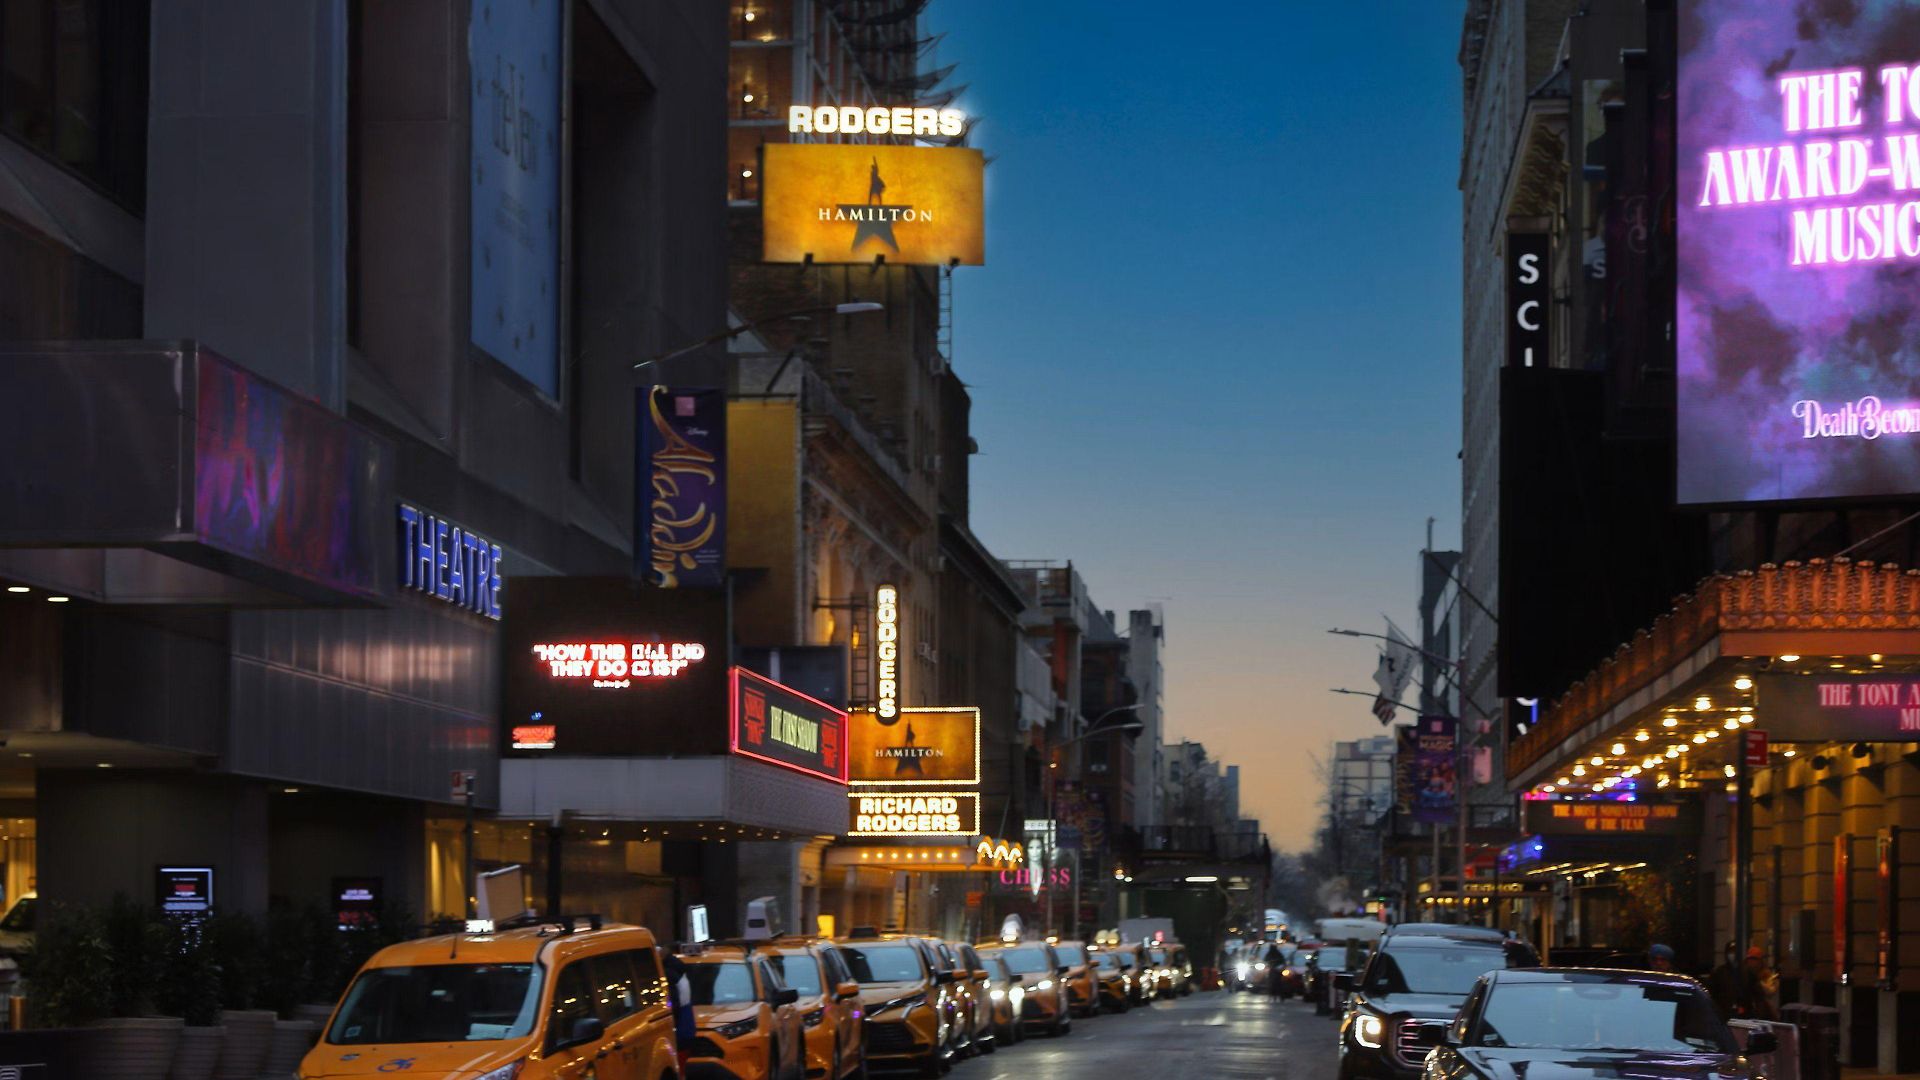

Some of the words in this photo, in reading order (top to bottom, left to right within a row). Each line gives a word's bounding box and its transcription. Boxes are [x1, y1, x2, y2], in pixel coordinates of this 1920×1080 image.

[1780, 71, 1862, 132] THE
[789, 105, 963, 136] RODGERS
[818, 207, 933, 222] HAMILTON
[1791, 201, 1920, 265] MUSIC
[399, 502, 502, 621] THEATRE
[671, 643, 705, 661] DID
[877, 588, 897, 718] RODGERS
[549, 660, 595, 677] THEY
[597, 660, 628, 677] DO
[1818, 683, 1852, 706] THE
[1857, 683, 1902, 706] TONY
[875, 748, 944, 758] HAMILTON
[860, 797, 958, 814] RICHARD
[1552, 803, 1570, 817] THE
[1573, 803, 1597, 817] MOST
[856, 814, 961, 831] RODGERS
[1584, 818, 1597, 831] OF
[1600, 818, 1617, 831] THE
